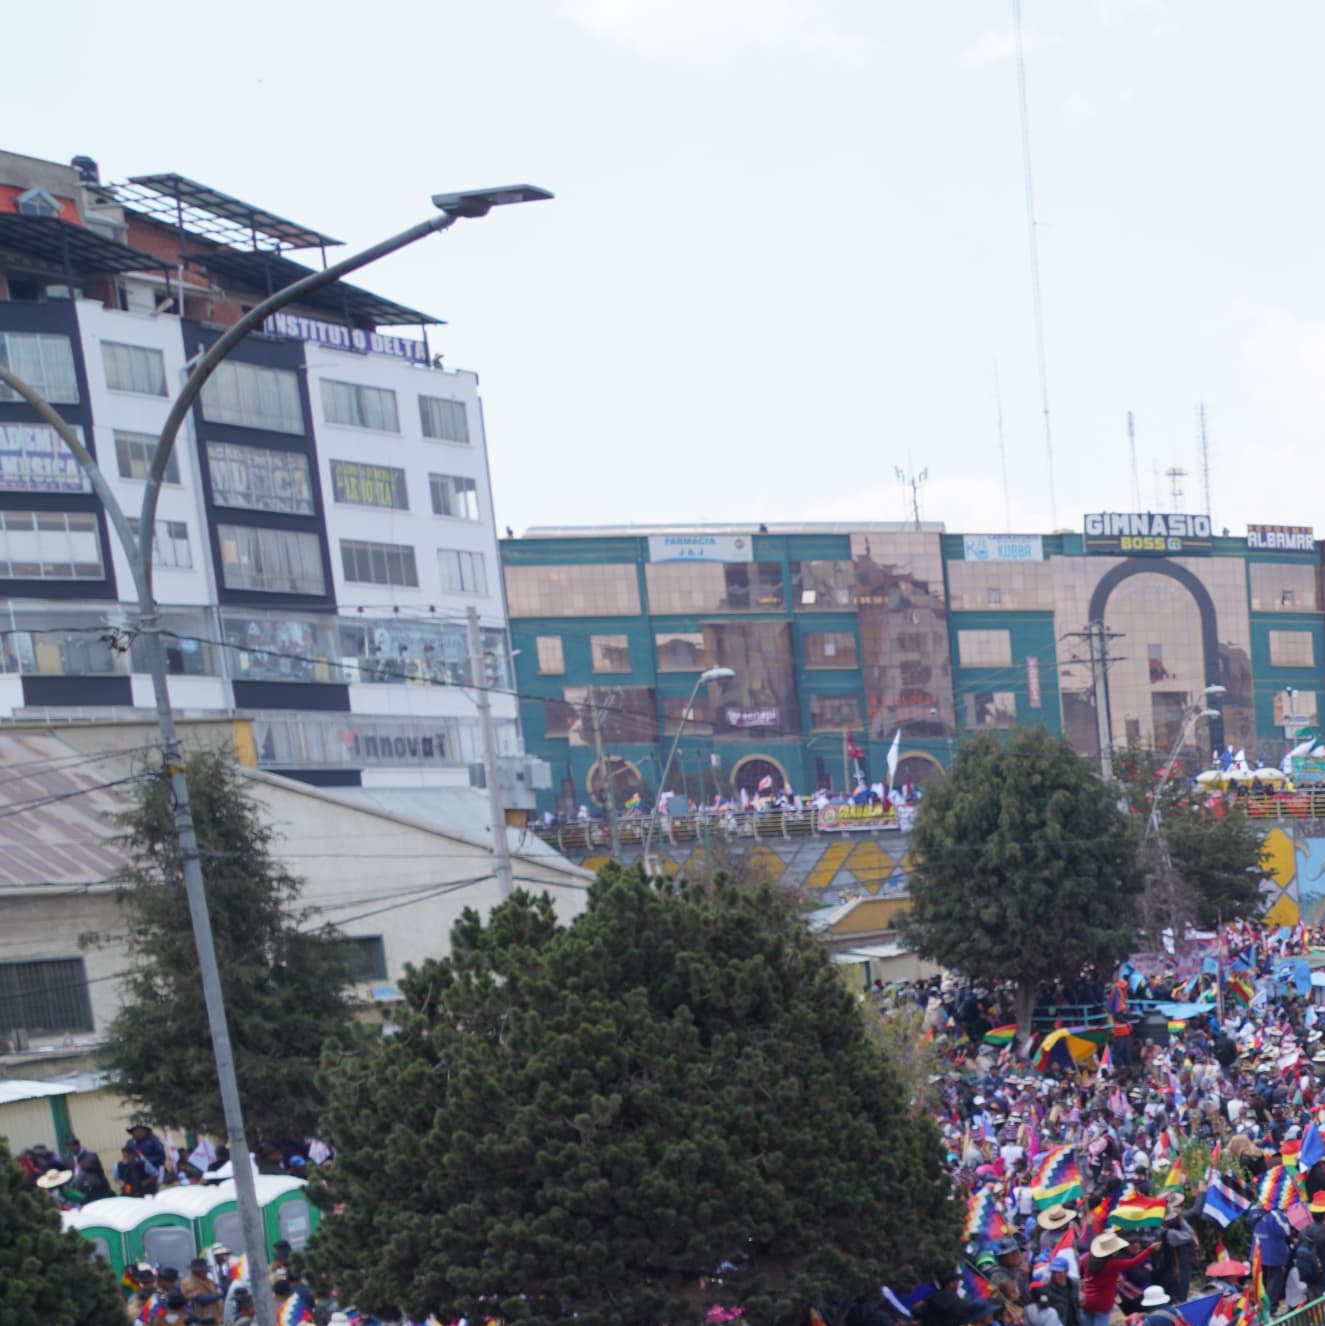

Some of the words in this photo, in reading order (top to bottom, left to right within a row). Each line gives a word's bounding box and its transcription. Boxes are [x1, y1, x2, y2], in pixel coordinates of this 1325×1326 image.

[266, 312, 367, 349] INSTITUTO
[371, 334, 427, 360] DELTA
[1085, 514, 1211, 537] GIMNASIO
[664, 536, 716, 546] FARMACIA
[1120, 537, 1165, 550] BOSS
[1247, 531, 1314, 551] ALBAMAR
